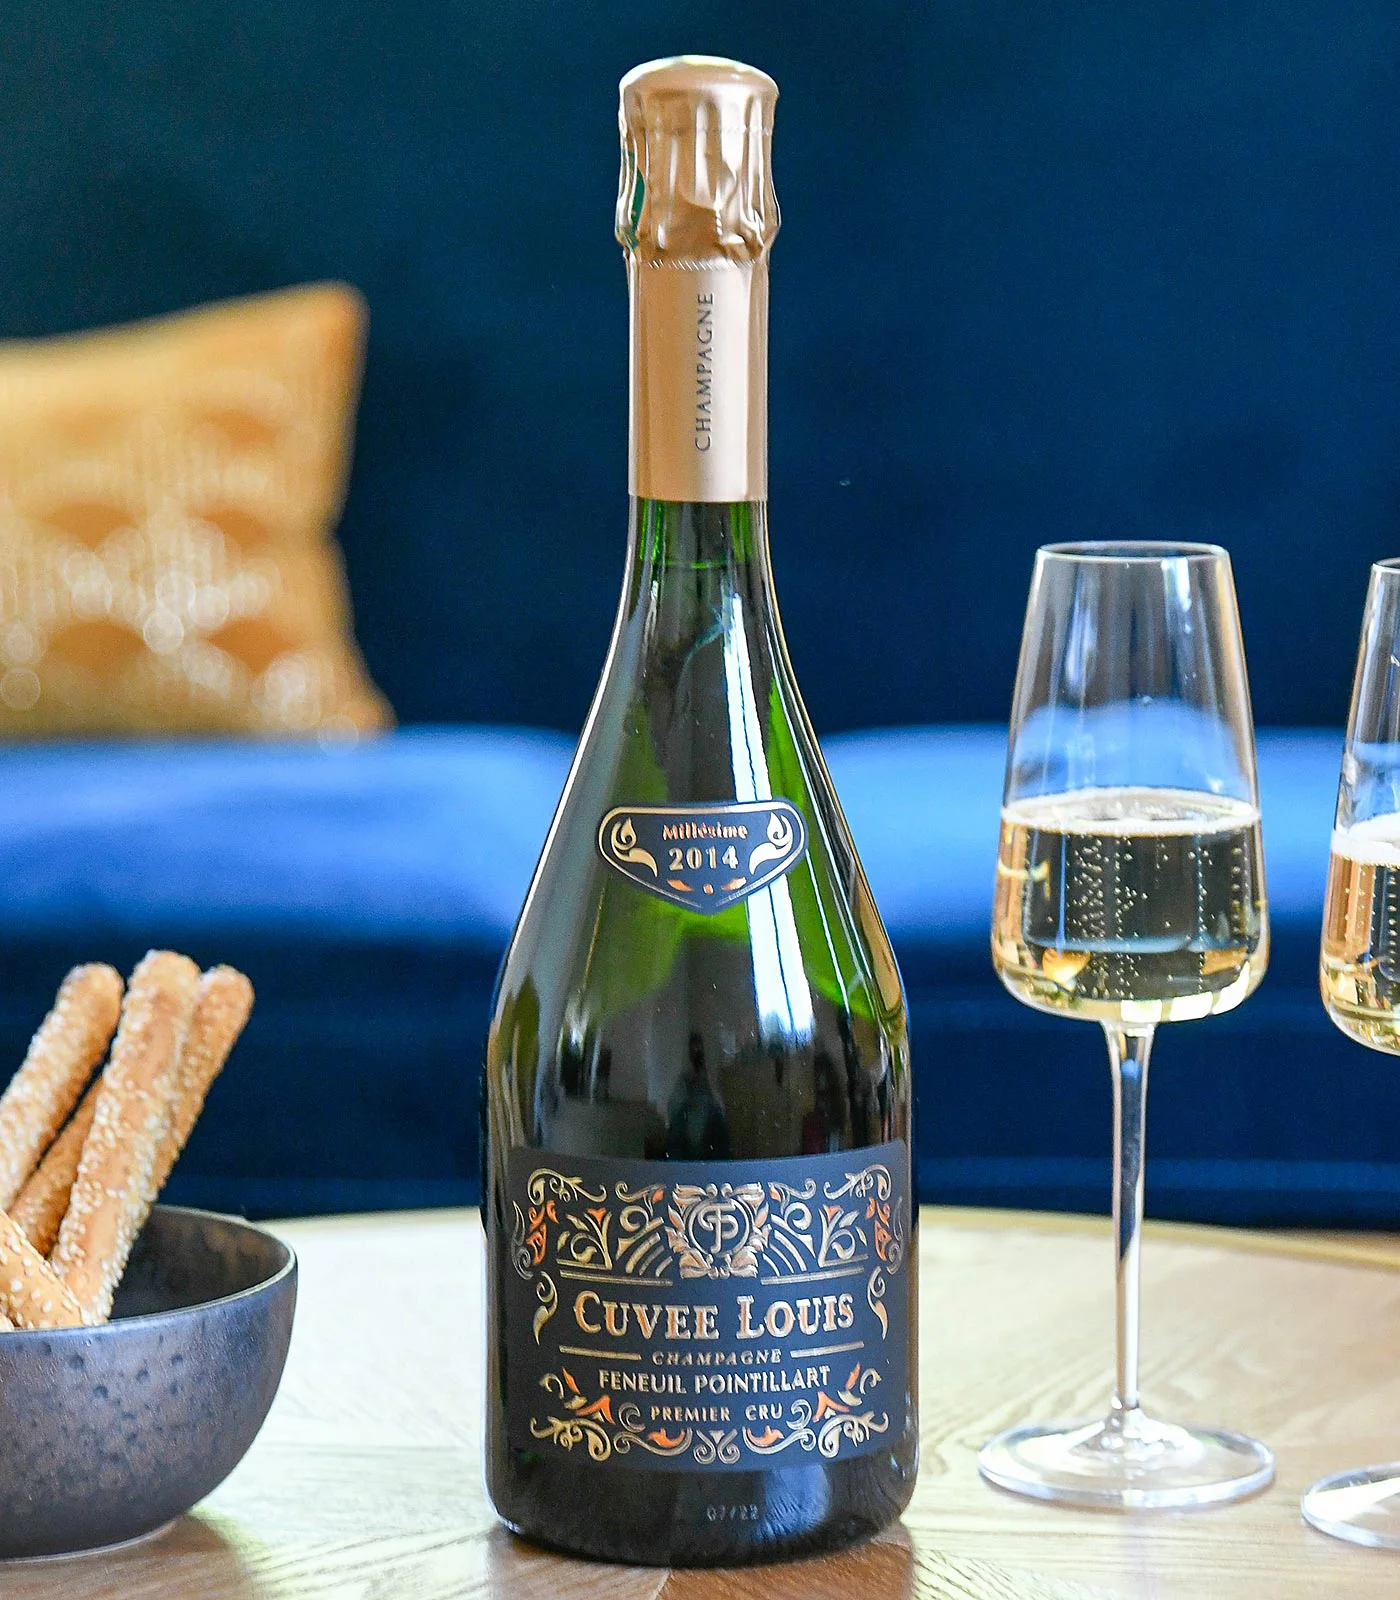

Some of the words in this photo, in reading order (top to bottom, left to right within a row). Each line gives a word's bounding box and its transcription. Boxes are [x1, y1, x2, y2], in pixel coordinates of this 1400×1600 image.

[695, 293, 713, 452] CHAMPAGNE
[668, 845, 739, 871] 2014
[573, 1290, 720, 1340] CUVEE
[736, 1293, 855, 1339] LOUIS
[651, 1348, 782, 1366] CHAMPAGNE
[599, 1369, 687, 1394] FENEUIL
[694, 1365, 830, 1395] POINTILLART
[650, 1405, 731, 1422] PREMIER
[745, 1402, 783, 1421] CRU
